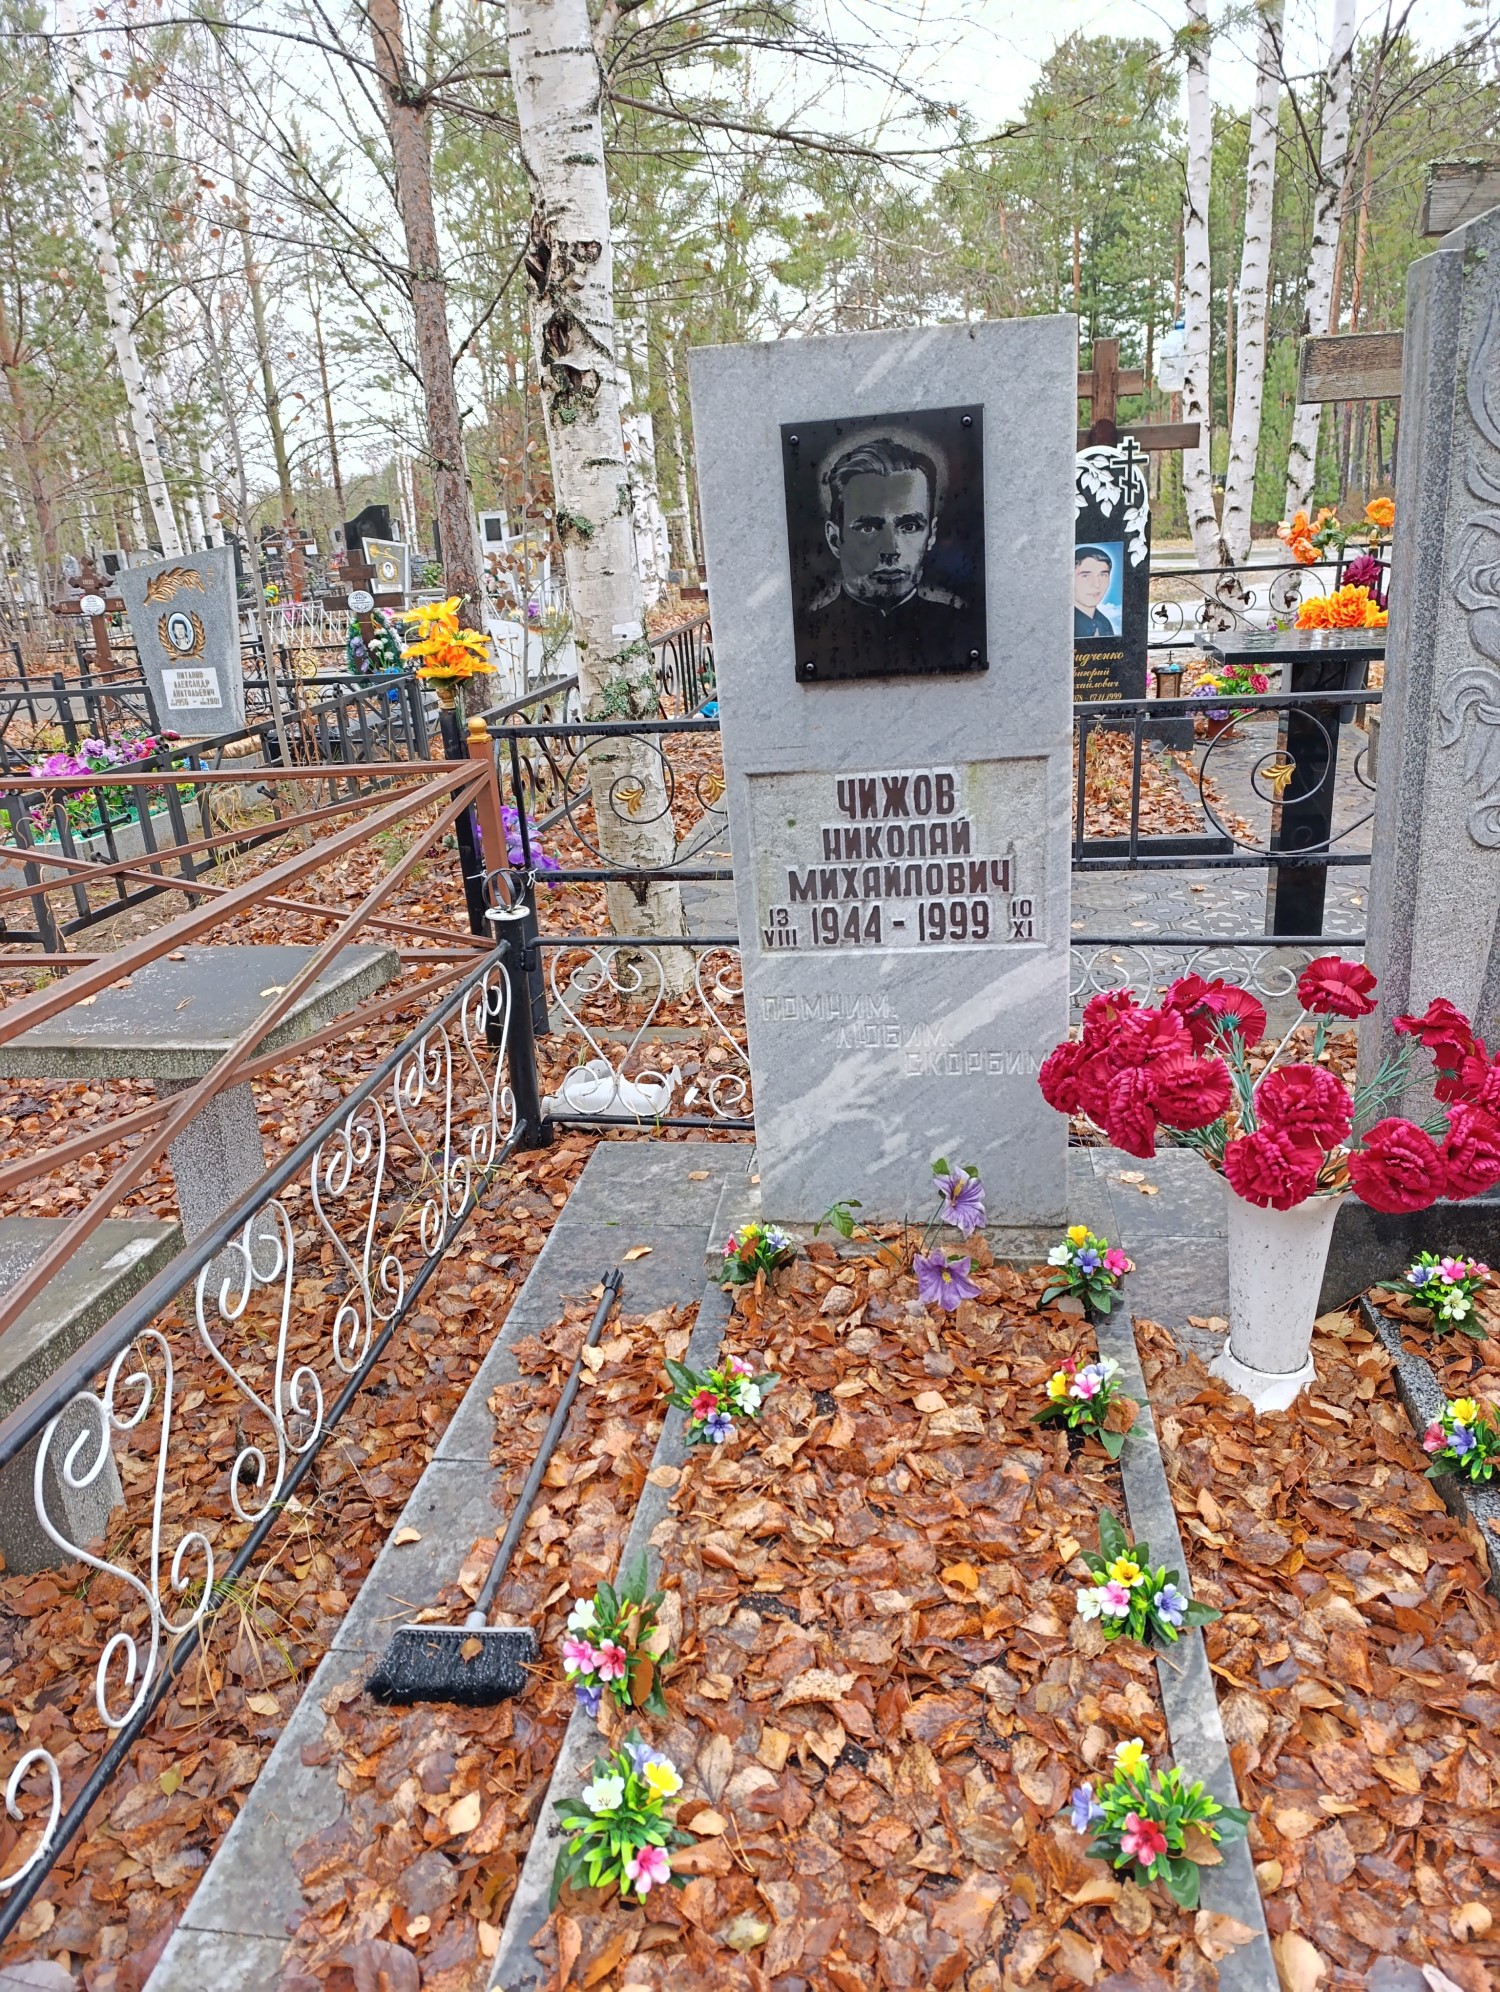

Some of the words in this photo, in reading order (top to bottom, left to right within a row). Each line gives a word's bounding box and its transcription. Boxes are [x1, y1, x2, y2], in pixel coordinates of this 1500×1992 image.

[1074, 649, 1123, 666] идченко
[173, 689, 215, 697] АНАТОЛЬЕВИЧ
[174, 680, 210, 688] АЛЕКСАНДР
[836, 773, 955, 819] ЧИЖОВ
[822, 816, 971, 861] НИКОЛАЙ
[788, 859, 1010, 902] МИХАЙЛОВИЧ
[763, 928, 798, 947] VIII
[1012, 919, 1033, 939] XI
[769, 908, 789, 927] 13
[811, 904, 882, 945] 1944
[918, 900, 990, 941] 1999
[1012, 899, 1033, 918] 10
[905, 1051, 1044, 1077] СКОРБИМ
